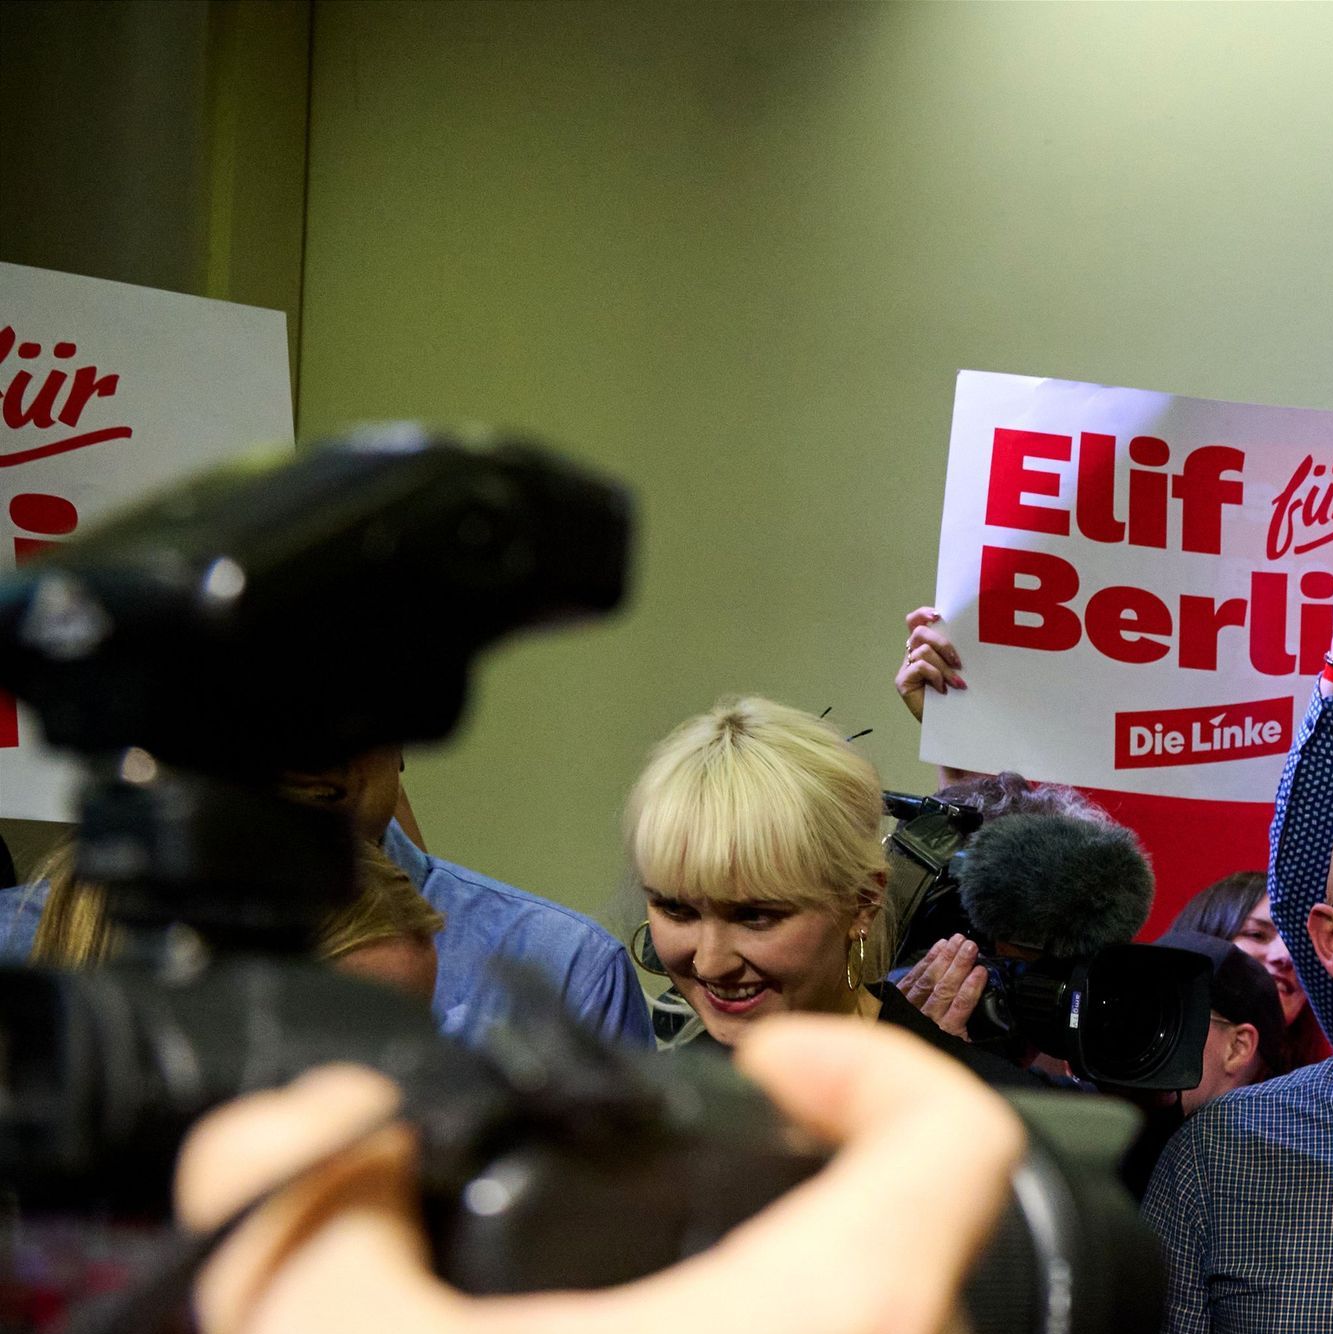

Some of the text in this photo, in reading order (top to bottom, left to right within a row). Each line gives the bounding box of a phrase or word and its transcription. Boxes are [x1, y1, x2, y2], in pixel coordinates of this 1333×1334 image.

[985, 427, 1246, 556] Elif
[1129, 713, 1282, 756] Die Linke
